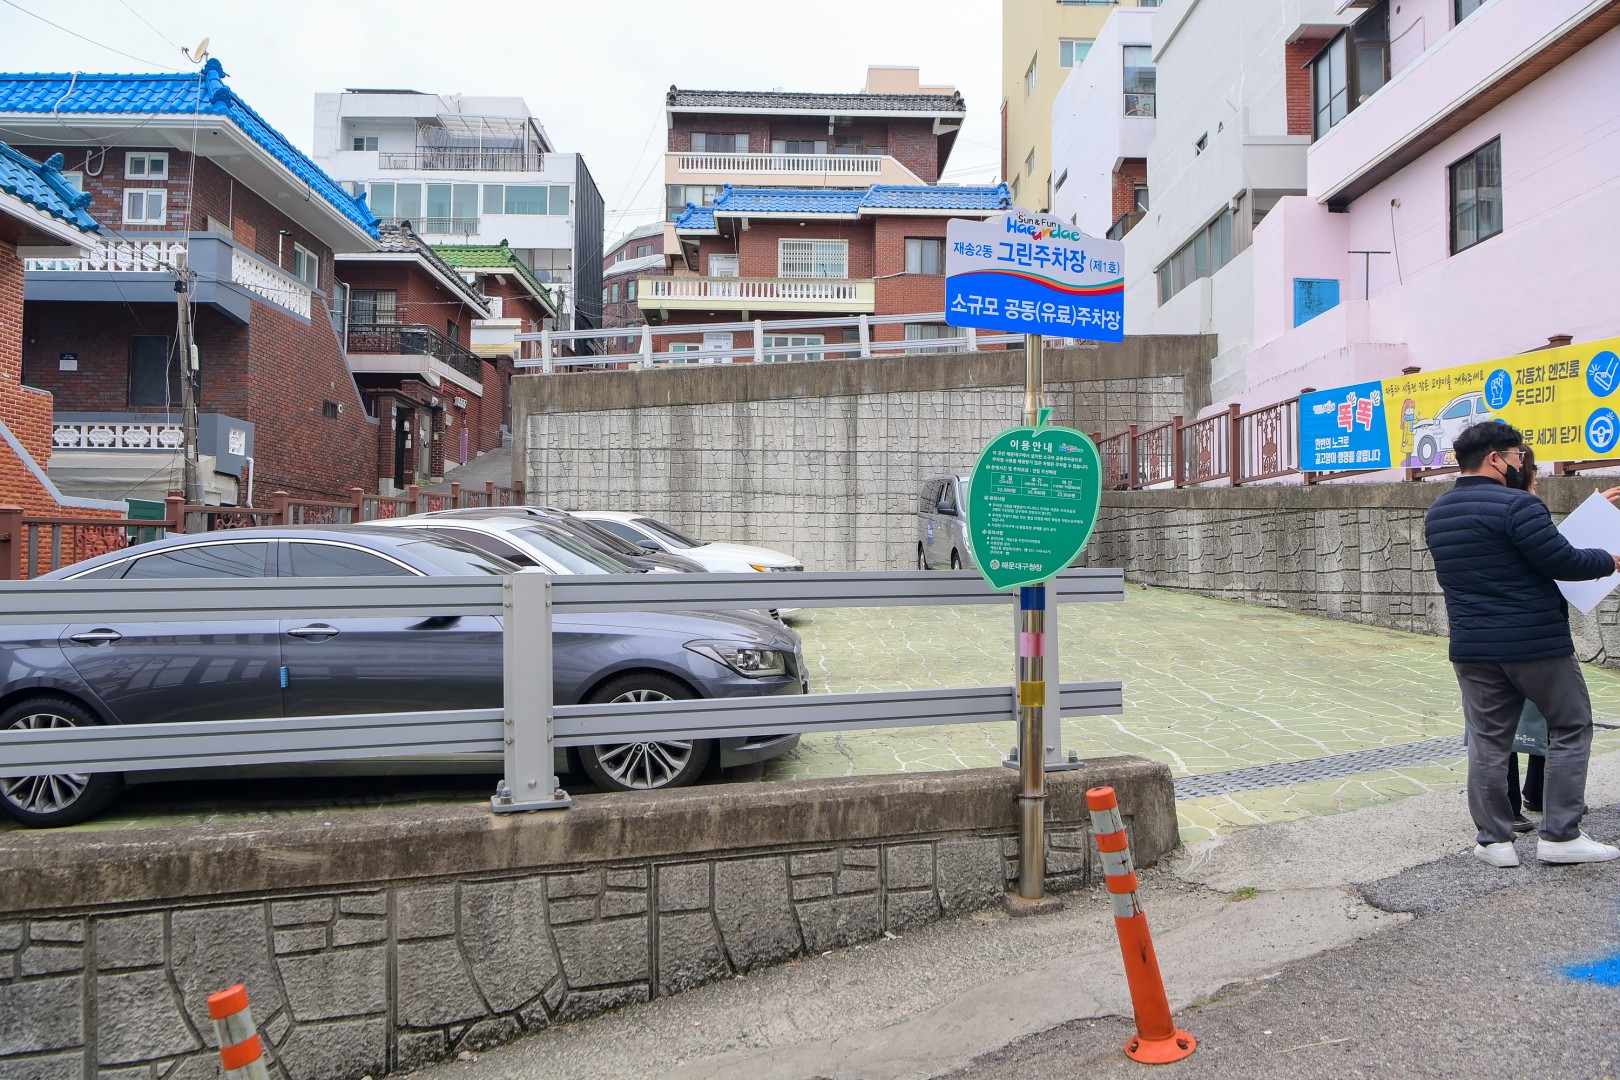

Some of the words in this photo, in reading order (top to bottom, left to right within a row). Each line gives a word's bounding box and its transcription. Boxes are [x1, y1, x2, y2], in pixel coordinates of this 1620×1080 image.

[1006, 216, 1081, 242] Haeundae
[1018, 214, 1035, 225] Sun
[1041, 218, 1057, 228] Fun
[953, 241, 993, 259] 재송2동
[997, 241, 1087, 273] 그린주차장
[1089, 257, 1121, 275] (제1호)
[950, 293, 1000, 316] 소규모
[1004, 298, 1121, 331] 공동(유료)주차장
[1515, 365, 1546, 385] 자동차
[1548, 359, 1580, 381] 엔진룸
[1515, 385, 1556, 407] 두드리기
[1315, 437, 1332, 450] 한번의
[1332, 435, 1350, 449] 노크로
[1536, 426, 1557, 446] 세게
[1560, 424, 1582, 444] 닫기
[1010, 439, 1053, 454] 이용안내
[1315, 451, 1337, 465] 길고양이
[1337, 450, 1355, 464] 생명을
[1355, 448, 1381, 463] 살립니다
[1001, 561, 1043, 572] 해운대구청장
